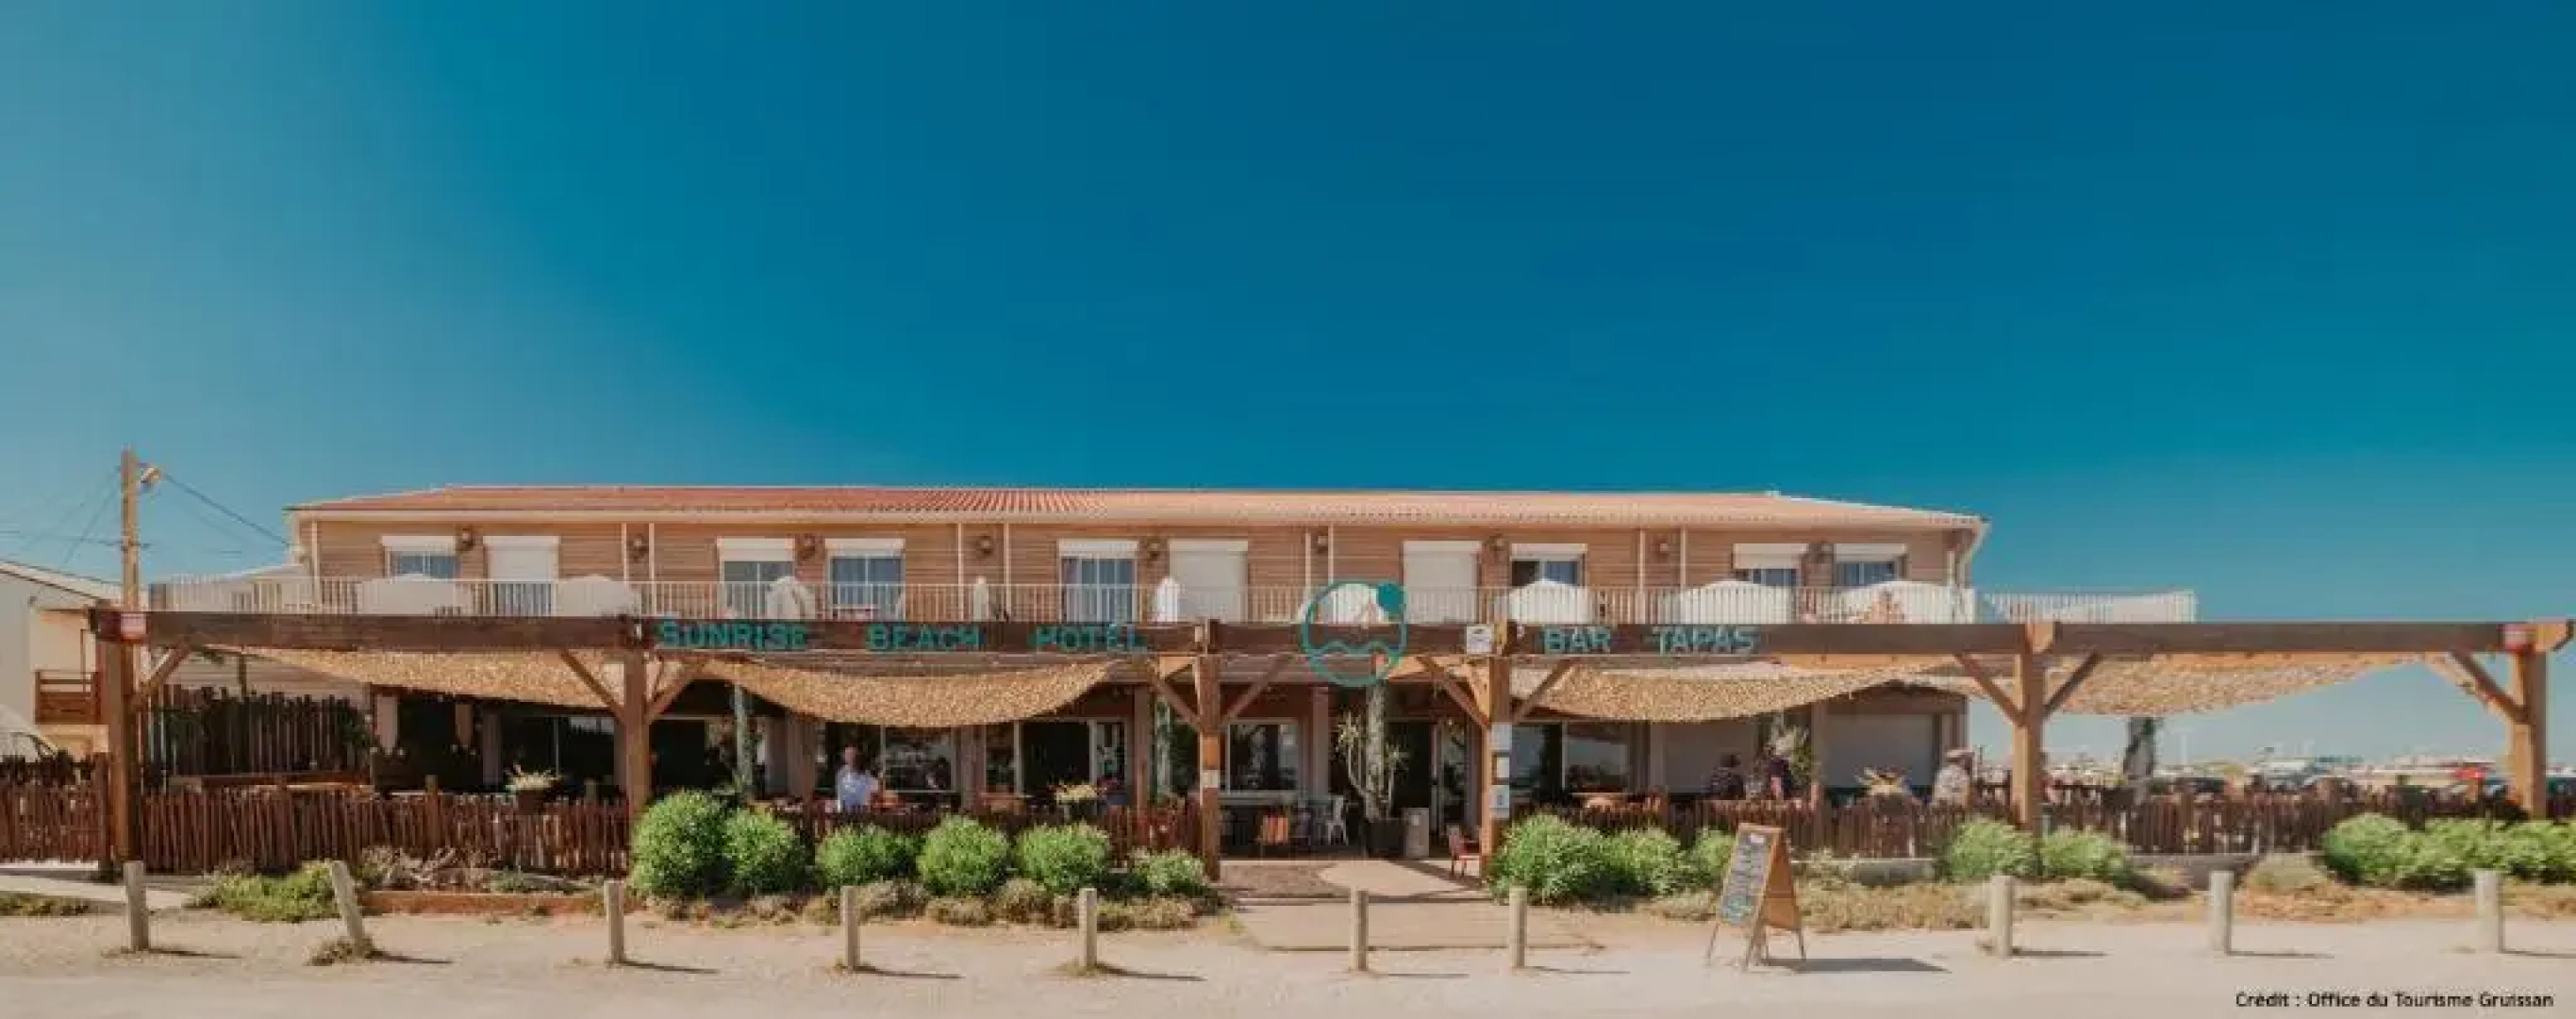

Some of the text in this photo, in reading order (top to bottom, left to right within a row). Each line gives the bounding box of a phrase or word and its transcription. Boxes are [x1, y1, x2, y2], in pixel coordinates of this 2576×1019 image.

[659, 620, 1147, 652] SUNRISE BEACH HOTEL
[1543, 626, 1756, 654] BAR TAPAS
